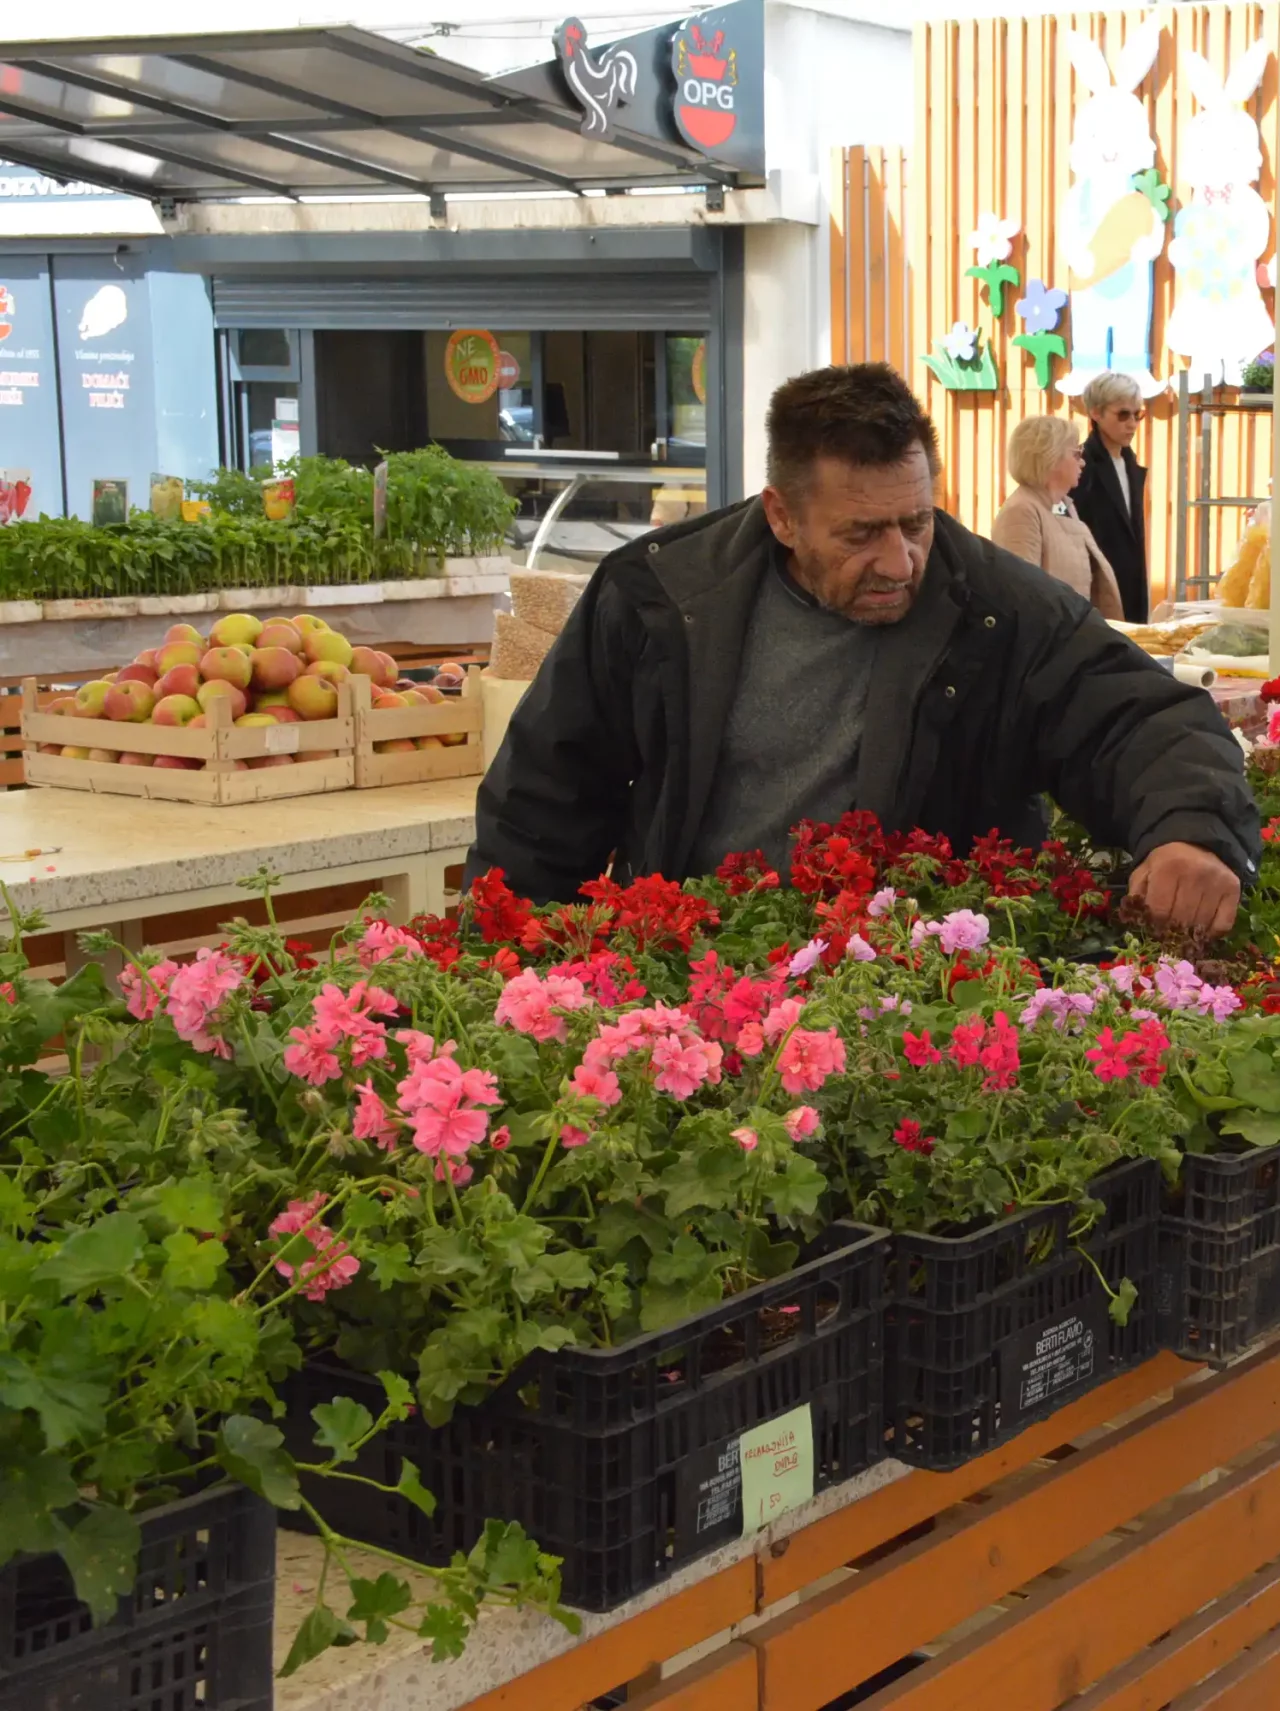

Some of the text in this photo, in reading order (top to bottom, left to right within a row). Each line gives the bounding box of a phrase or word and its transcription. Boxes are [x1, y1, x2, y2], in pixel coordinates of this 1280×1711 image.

[683, 79, 734, 109] OPG
[456, 336, 477, 360] NE
[460, 367, 488, 385] GMO
[1036, 1333, 1058, 1356] BERTI
[1058, 1320, 1083, 1345] FLAVIO
[718, 1449, 739, 1473] BER
